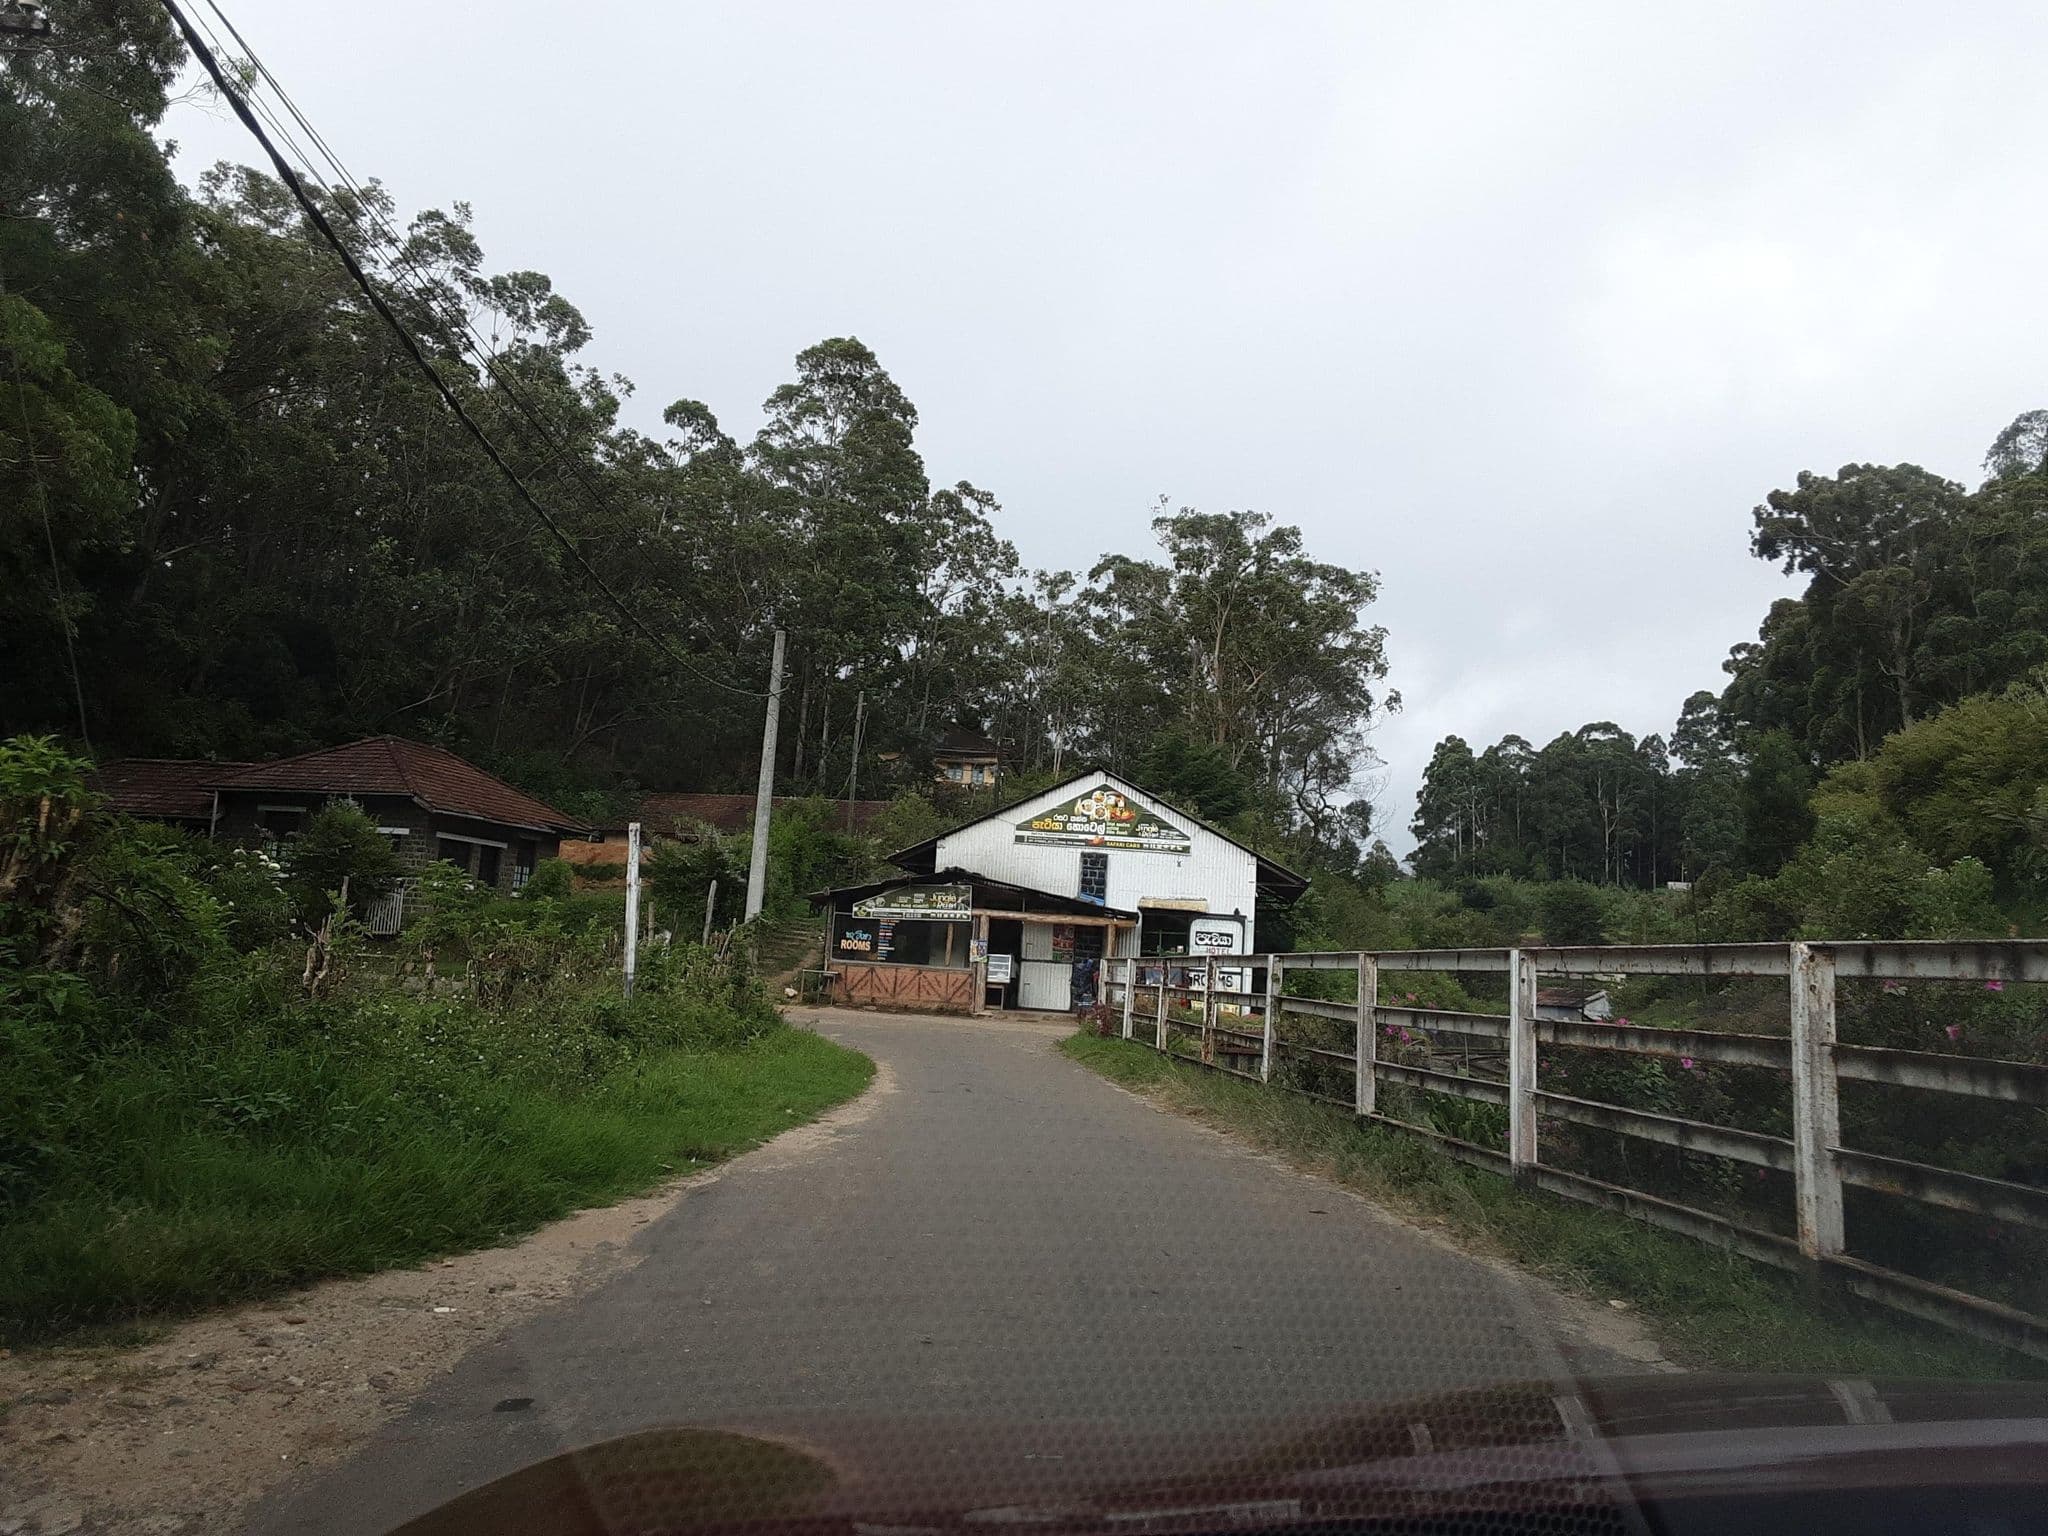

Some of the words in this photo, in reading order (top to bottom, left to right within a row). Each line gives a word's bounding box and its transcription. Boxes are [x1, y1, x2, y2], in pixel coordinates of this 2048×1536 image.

[930, 894, 957, 904] Jungle
[840, 939, 871, 951] ROOMS
[1206, 946, 1233, 955] HOTEL
[1193, 973, 1233, 988] ROMS
